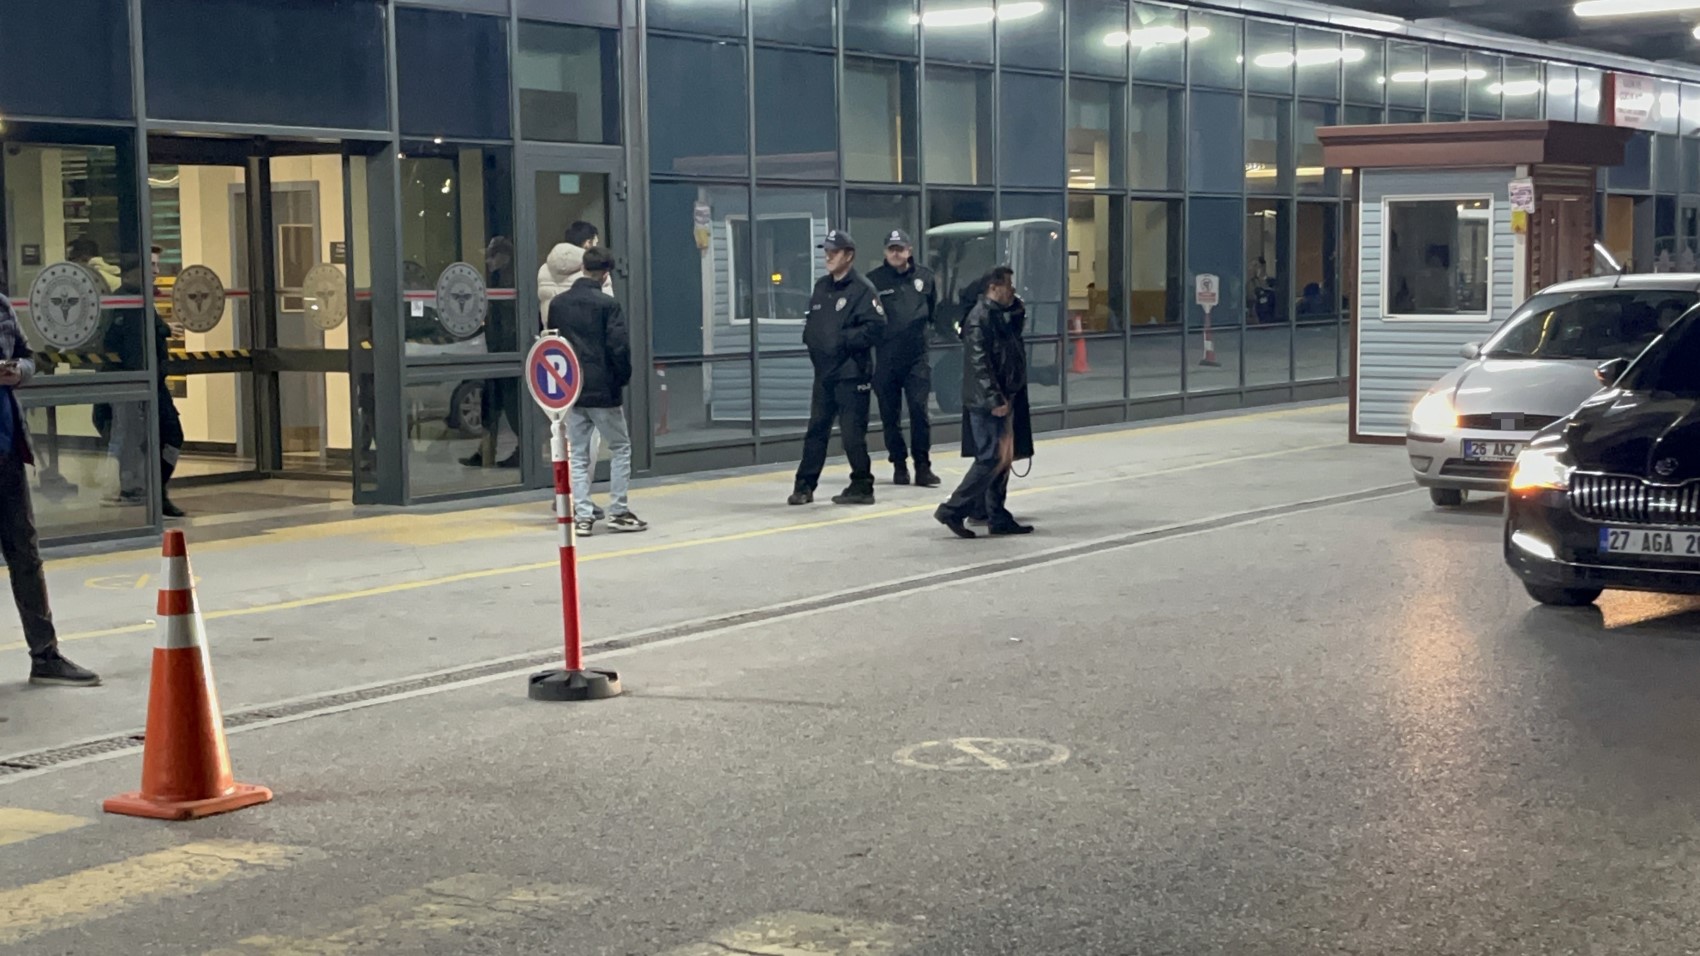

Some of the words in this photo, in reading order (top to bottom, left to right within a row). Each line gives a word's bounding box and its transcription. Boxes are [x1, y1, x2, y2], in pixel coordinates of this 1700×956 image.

[545, 354, 568, 394] P
[1472, 443, 1487, 456] 26
[1493, 443, 1516, 456] AKZ
[1609, 530, 1630, 550] 27
[1641, 532, 1673, 553] AGA
